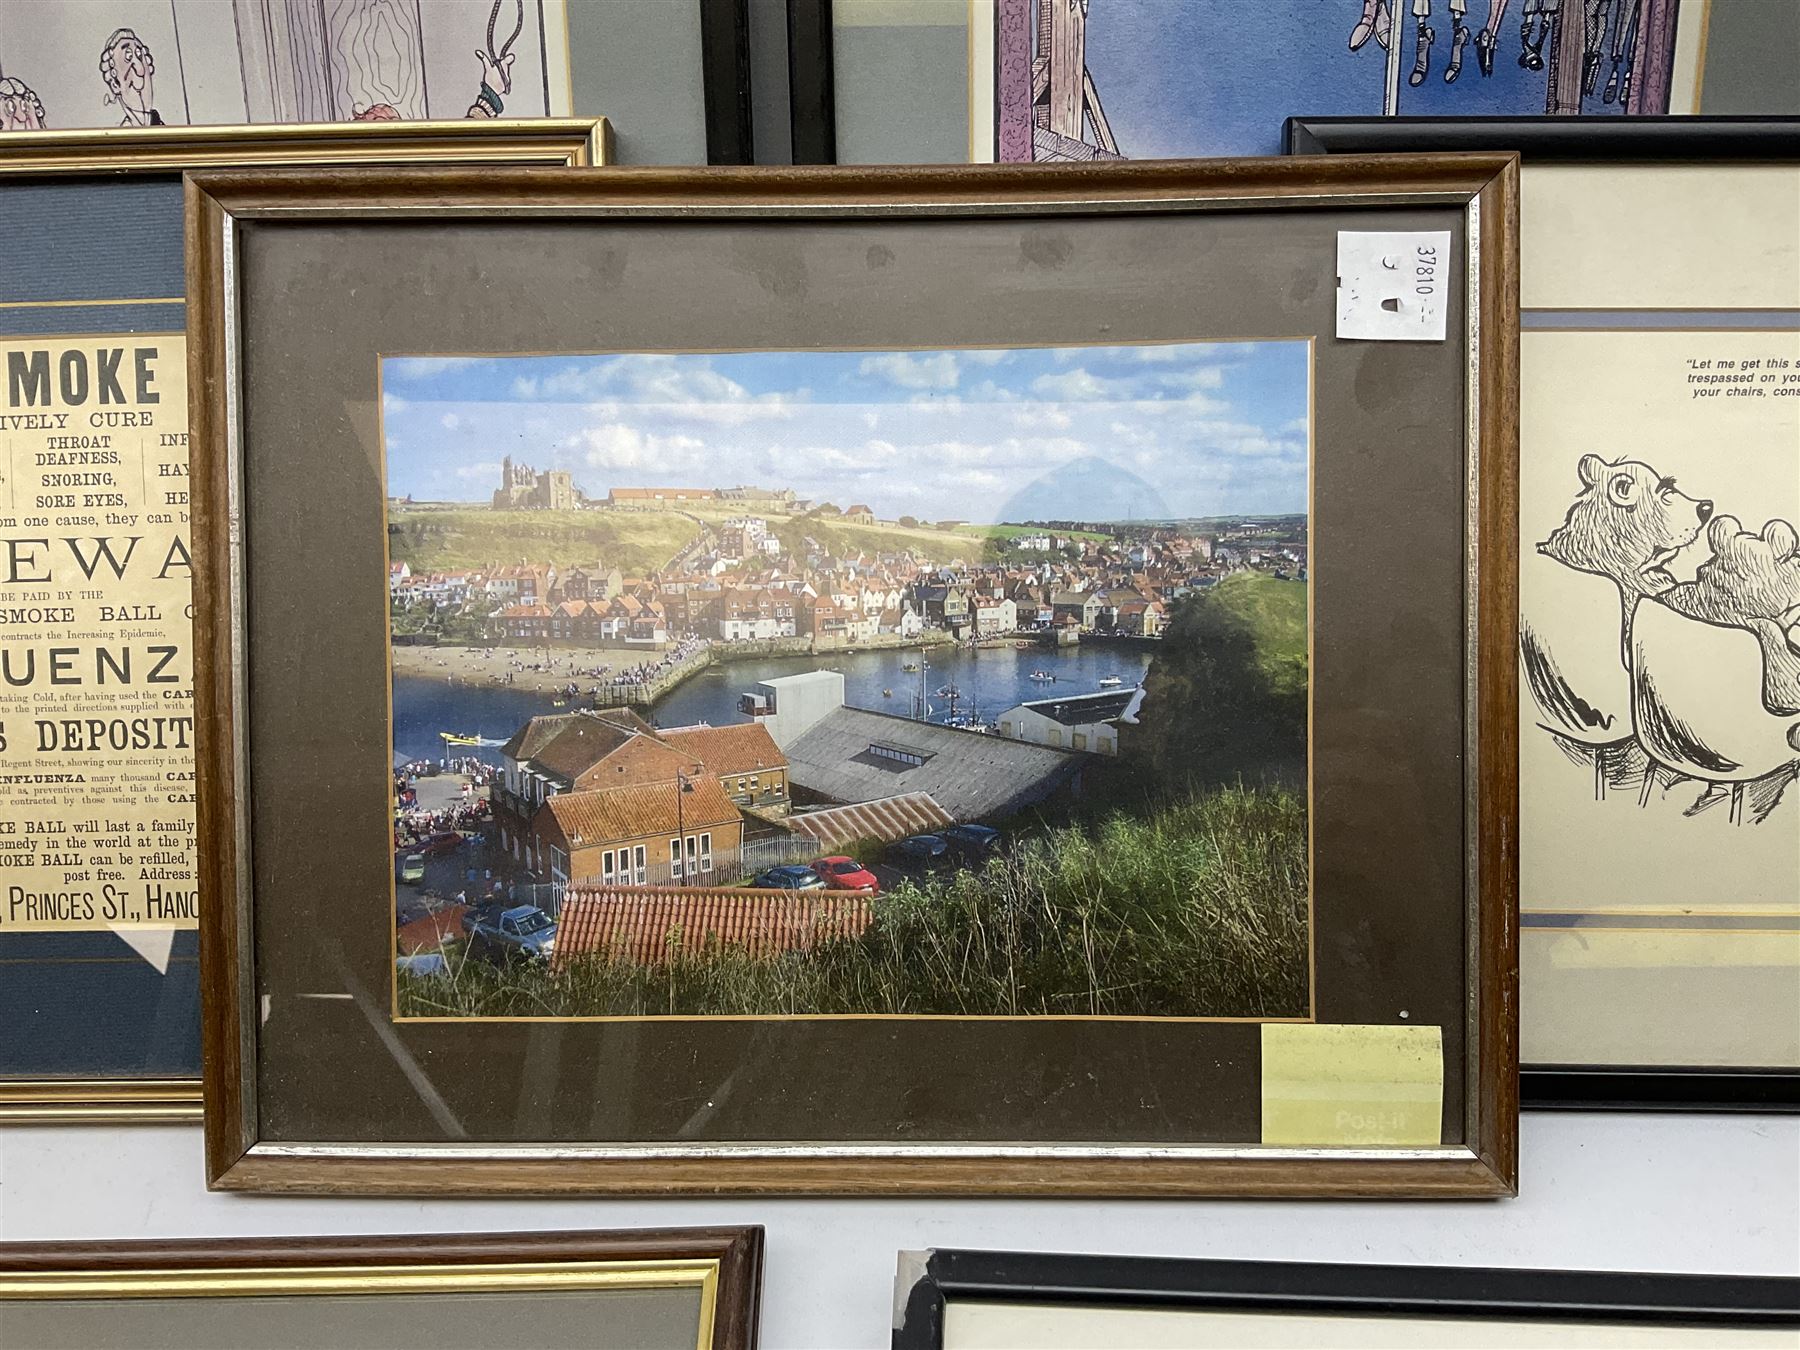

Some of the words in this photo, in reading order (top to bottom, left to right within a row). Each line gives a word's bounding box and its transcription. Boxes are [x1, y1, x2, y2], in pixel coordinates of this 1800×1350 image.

[1717, 360, 1735, 369] me
[1740, 360, 1761, 371] get
[1766, 358, 1789, 369] this
[8, 347, 160, 407] MOKE
[1687, 372, 1755, 385] trespassed
[1760, 374, 1776, 383] on
[1692, 388, 1720, 399] your
[1726, 386, 1767, 398] chairs,
[90, 411, 153, 428] CURE
[47, 435, 111, 450] THROAT
[35, 451, 122, 466] DEAFNESS,
[41, 472, 117, 487] SNORING,
[36, 494, 76, 508] SORE
[83, 493, 128, 508] EYES,
[24, 515, 49, 527] one
[55, 514, 99, 527] cause,
[105, 512, 139, 527] they
[147, 513, 173, 524] can
[1, 592, 16, 602] BE
[23, 591, 50, 601] PAID
[58, 590, 73, 600] BY
[79, 590, 104, 600] THE
[0, 607, 75, 625] SMOKE
[99, 605, 162, 622] BALL
[1, 632, 42, 641] contracts
[47, 630, 62, 640] the
[67, 629, 114, 641] Increasing
[120, 629, 166, 639] Epidemic,
[2, 645, 193, 687] UENZ
[33, 692, 57, 702] Cold,
[59, 692, 82, 702] after
[84, 691, 116, 703] having
[119, 690, 140, 700] used
[142, 690, 158, 700] the
[1, 704, 10, 714] to
[15, 703, 30, 713] the
[34, 702, 68, 715] printed
[73, 702, 118, 712] directions
[120, 701, 159, 713] supplied
[164, 700, 185, 710] with
[34, 716, 193, 752] DEPOSIT
[1, 759, 32, 769] Regent
[35, 758, 64, 768] Street,
[67, 757, 105, 768] showing
[107, 758, 123, 767] our
[125, 755, 165, 767] sincerity
[168, 755, 178, 765] in
[91, 774, 116, 785] many
[120, 771, 161, 782] thousand
[34, 786, 84, 797] preventives
[90, 784, 122, 795] against
[130, 783, 147, 793] this
[154, 783, 188, 794] disease,
[10, 796, 57, 806] contracted
[63, 795, 75, 807] by
[82, 794, 105, 805] those
[112, 795, 137, 806] using
[144, 794, 160, 804] the
[25, 821, 67, 834] BALL
[73, 820, 100, 833] will
[105, 819, 130, 833] last
[136, 822, 146, 832] a
[151, 818, 194, 835] family
[46, 837, 59, 849] in
[66, 836, 87, 849] the
[93, 835, 131, 849] world
[137, 836, 151, 848] at
[159, 835, 179, 847] the
[41, 854, 83, 867] BALL
[89, 855, 113, 866] can
[120, 852, 133, 865] be
[140, 851, 189, 866] refilled,
[64, 870, 90, 885] post
[97, 869, 125, 881] free.
